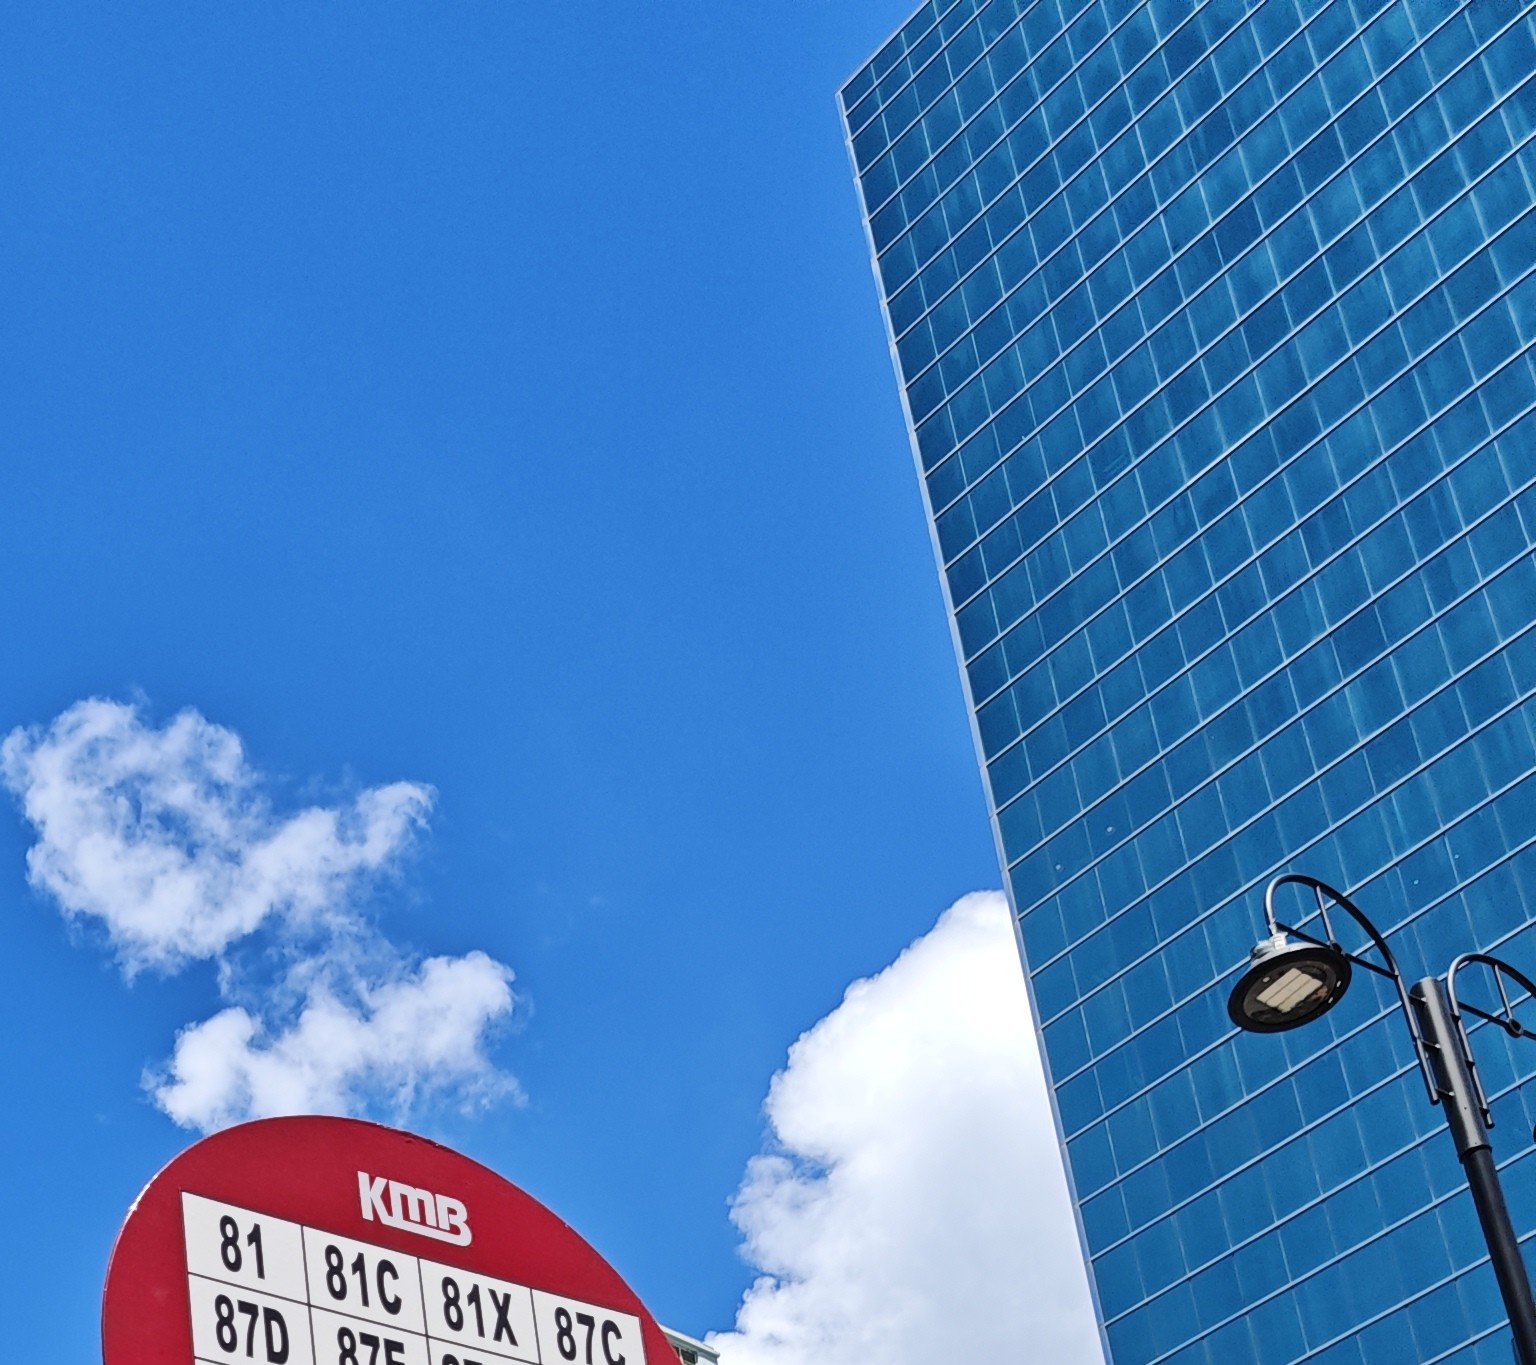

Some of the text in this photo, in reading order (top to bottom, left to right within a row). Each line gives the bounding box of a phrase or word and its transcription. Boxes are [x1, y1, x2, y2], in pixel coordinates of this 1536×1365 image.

[214, 1294, 289, 1365] 87D
[219, 1215, 265, 1279] 81
[325, 1245, 401, 1314] 81C
[442, 1276, 518, 1346] 81X
